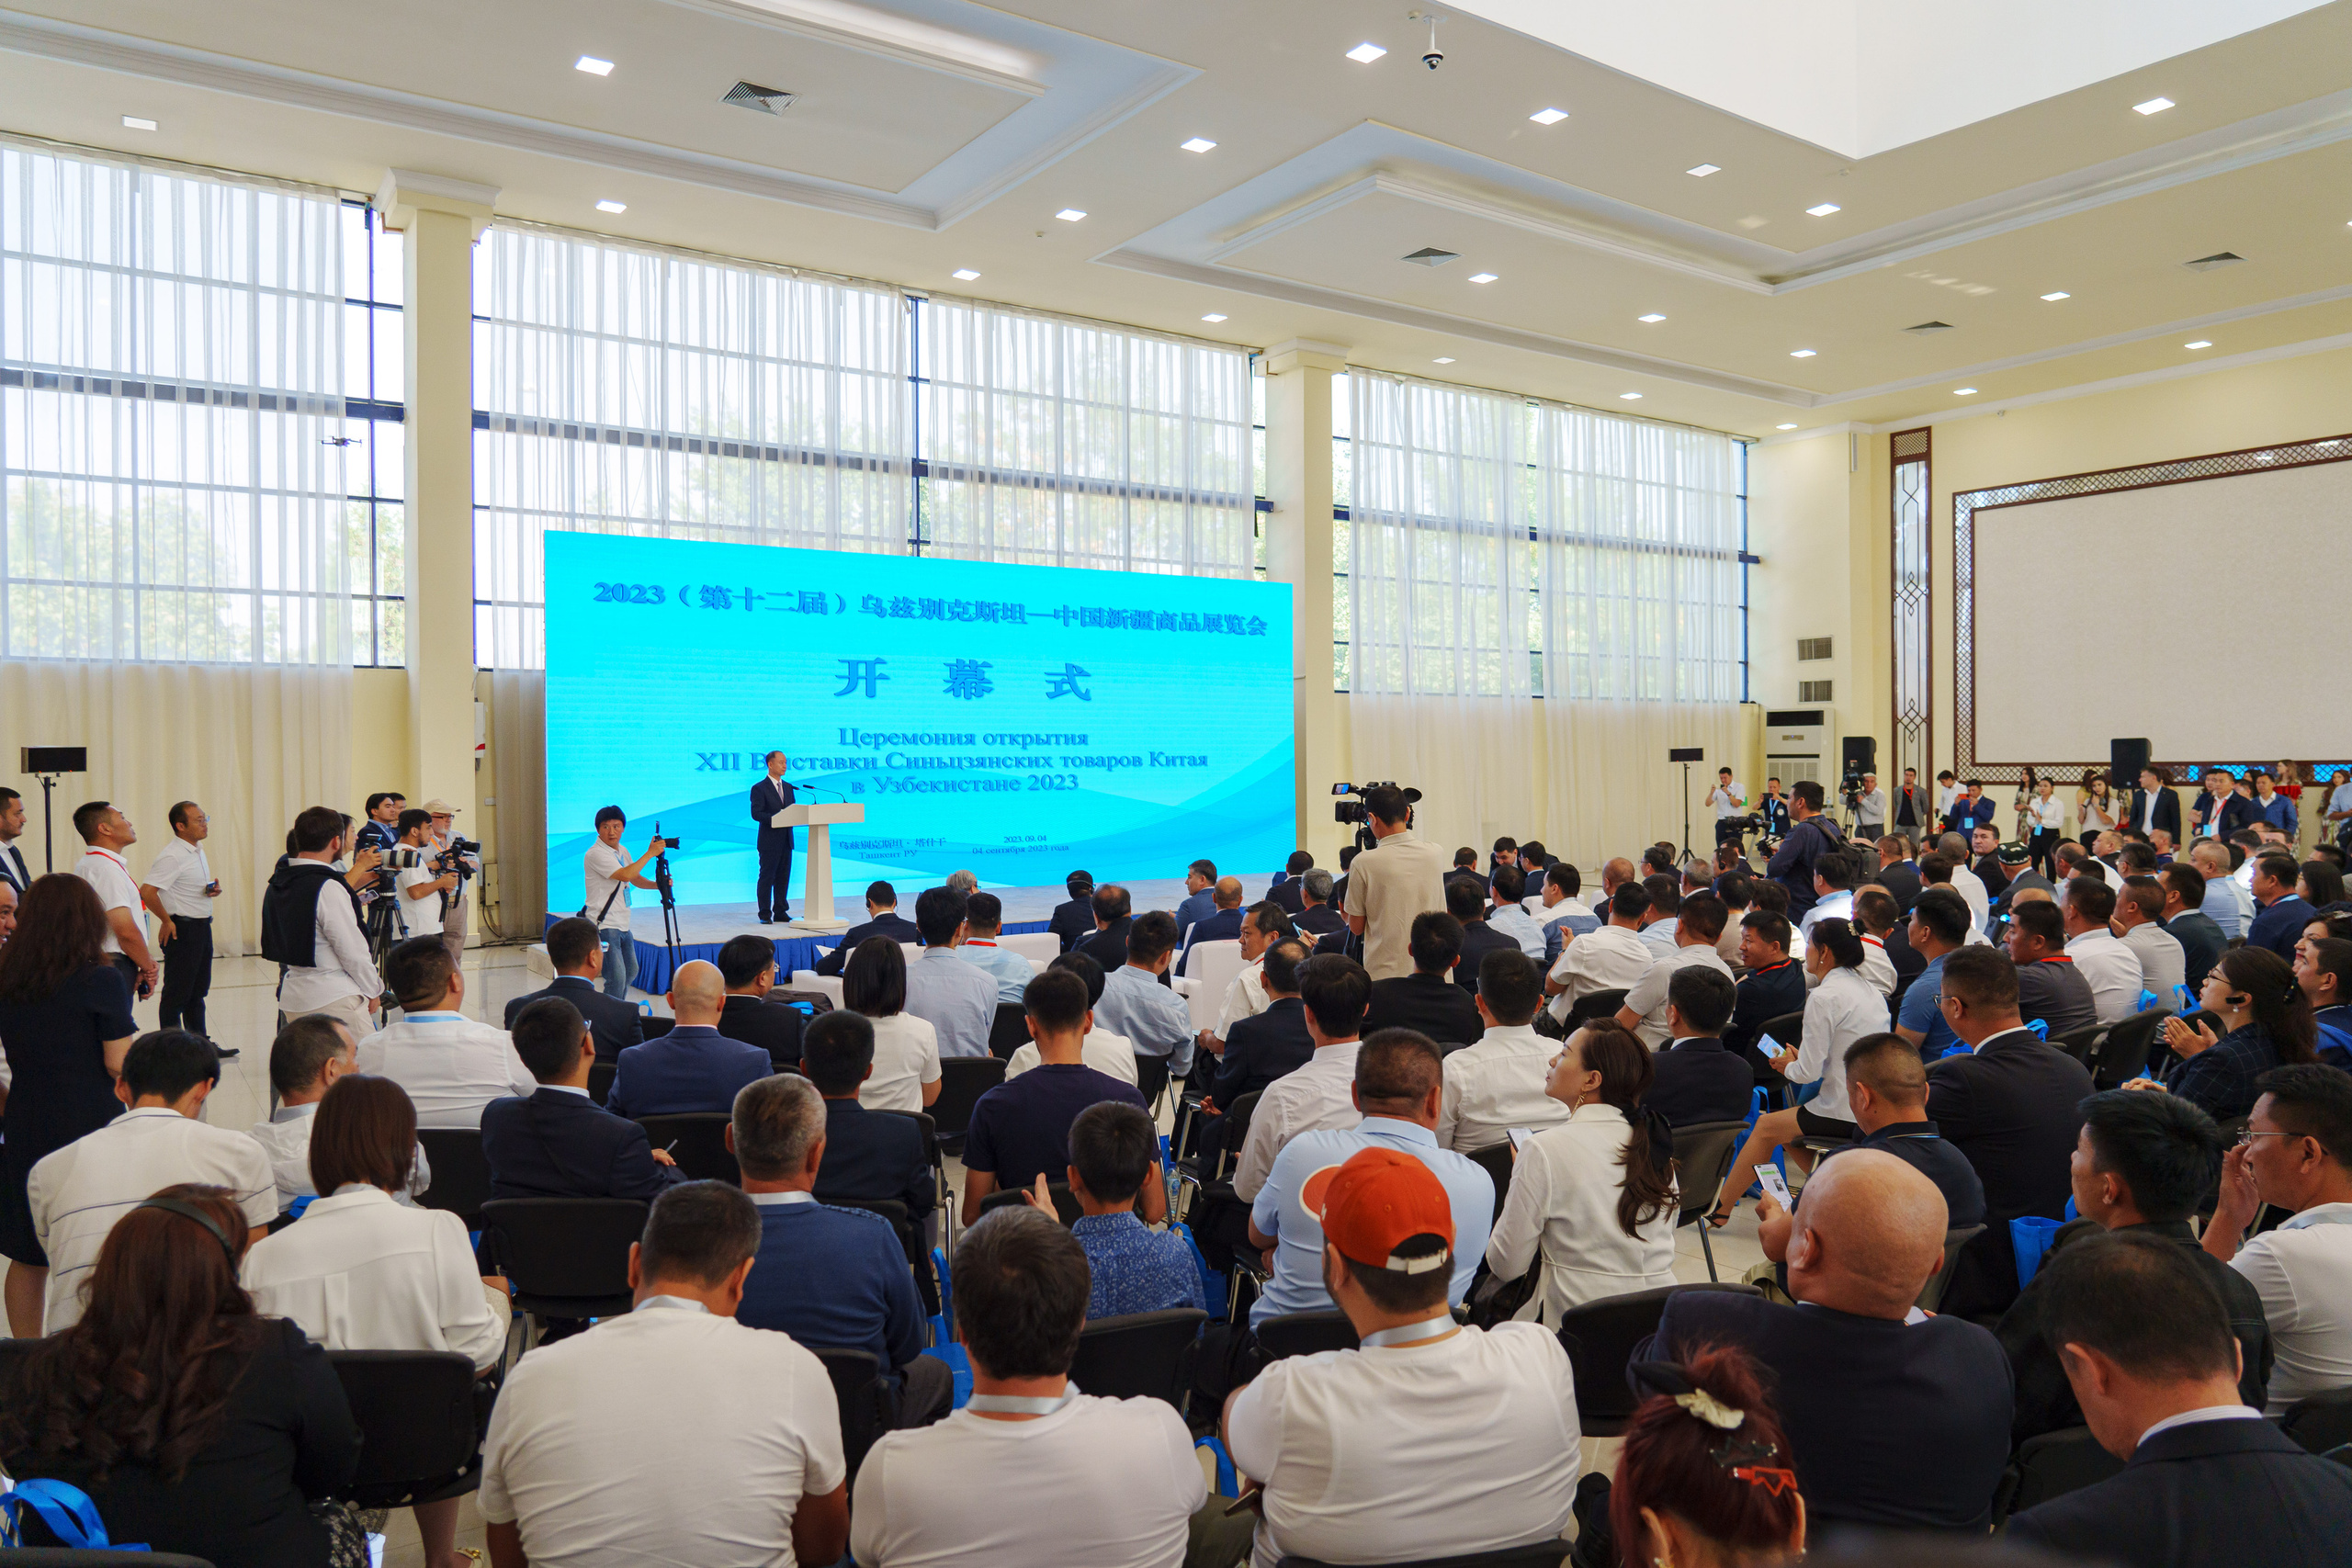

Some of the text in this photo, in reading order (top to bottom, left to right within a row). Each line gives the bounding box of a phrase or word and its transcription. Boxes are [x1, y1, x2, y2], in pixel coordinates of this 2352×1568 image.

[593, 581, 666, 605] 2023
[838, 728, 1089, 750] Церемония открытия
[885, 751, 1054, 771] Синьцзянских
[1059, 755, 1144, 772] товаров
[1148, 750, 1208, 767] Китая
[849, 773, 1080, 795] в Узбекистане 2023
[972, 847, 983, 855] 04
[1027, 844, 1048, 853] 2023
